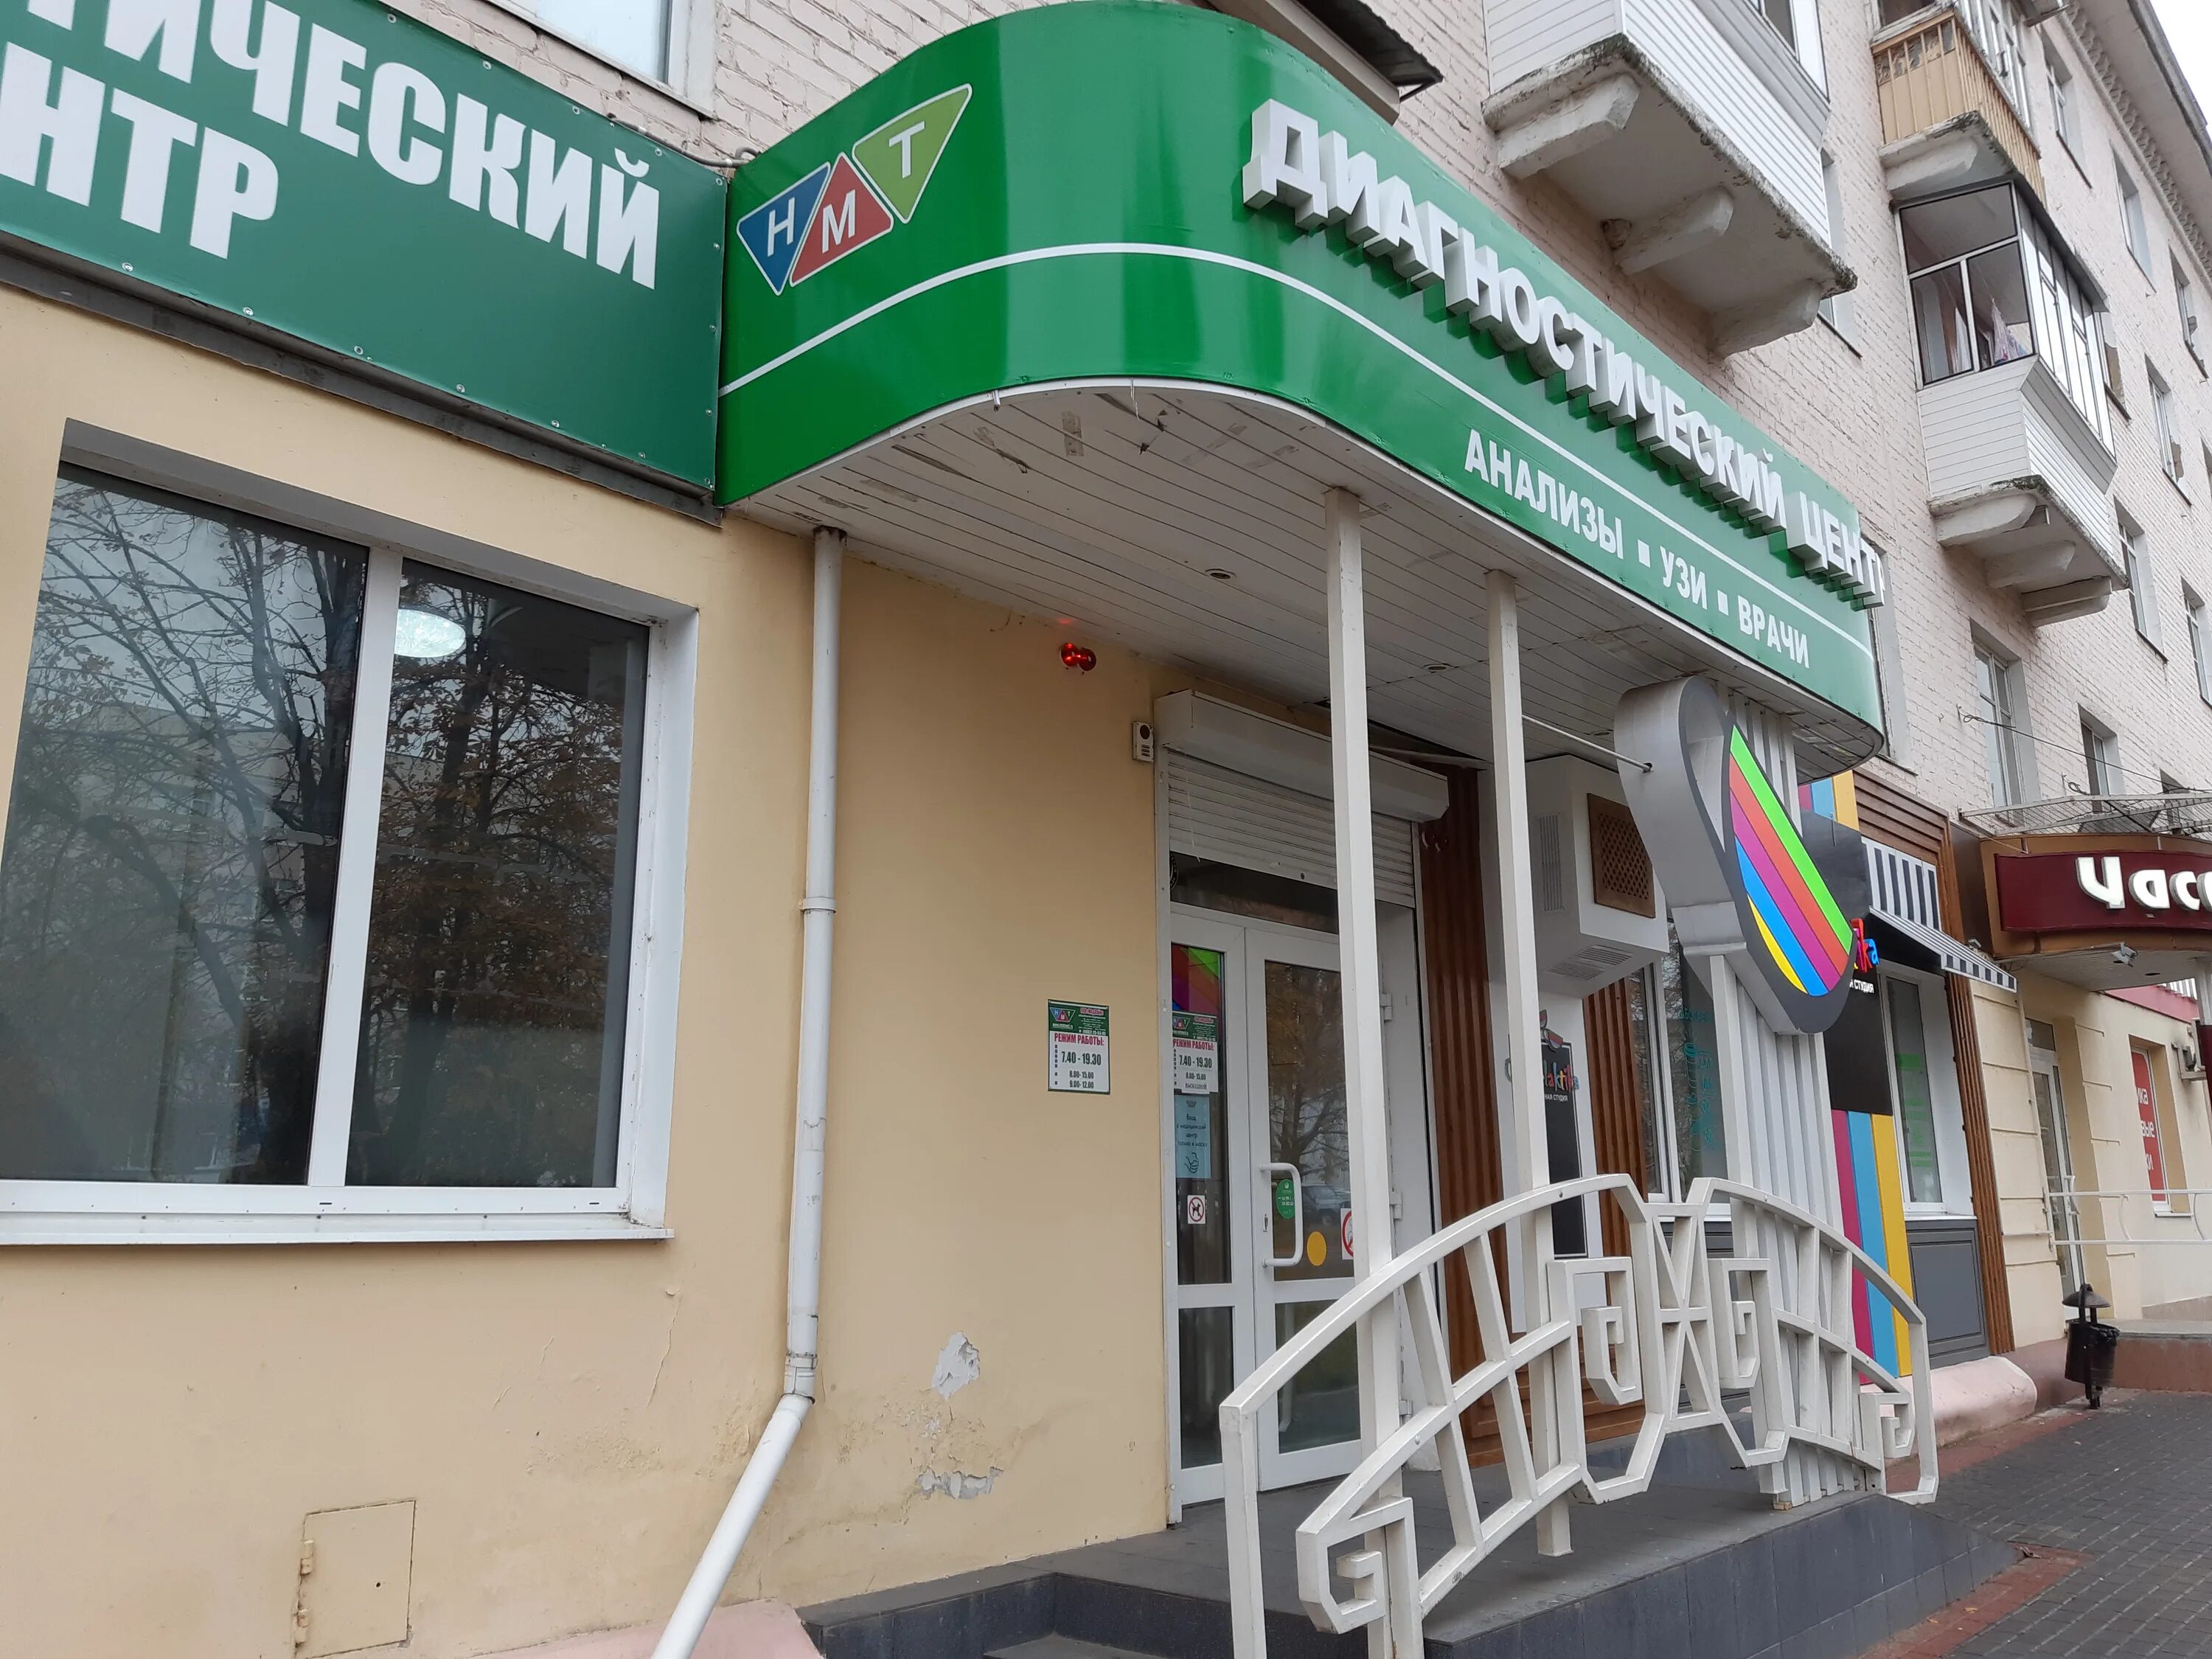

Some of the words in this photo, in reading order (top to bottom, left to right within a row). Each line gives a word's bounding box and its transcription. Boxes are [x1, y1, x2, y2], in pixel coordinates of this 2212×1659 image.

[1242, 99, 1787, 533] ДИАГНОСТИЧЕСКИЙ
[1464, 428, 1624, 560] АНАЛИЗЫ
[1660, 546, 1708, 610] УЗИ
[1737, 595, 1810, 669] ВРАЧИ
[1854, 978, 1874, 994] СТУДИЯ
[1054, 1032, 1077, 1043] РЕЖИМ
[1077, 1034, 1105, 1046] РАБОТЫ:
[1173, 1038, 1191, 1048] РЕЖИМ
[1192, 1040, 1214, 1051] РАБОТЫ:
[1061, 1051, 1077, 1064] 7.40
[1082, 1053, 1102, 1065] 19.30
[1179, 1054, 1192, 1067] 7.40
[1196, 1056, 1213, 1069] 19.30
[1543, 1060, 1580, 1093] laktika
